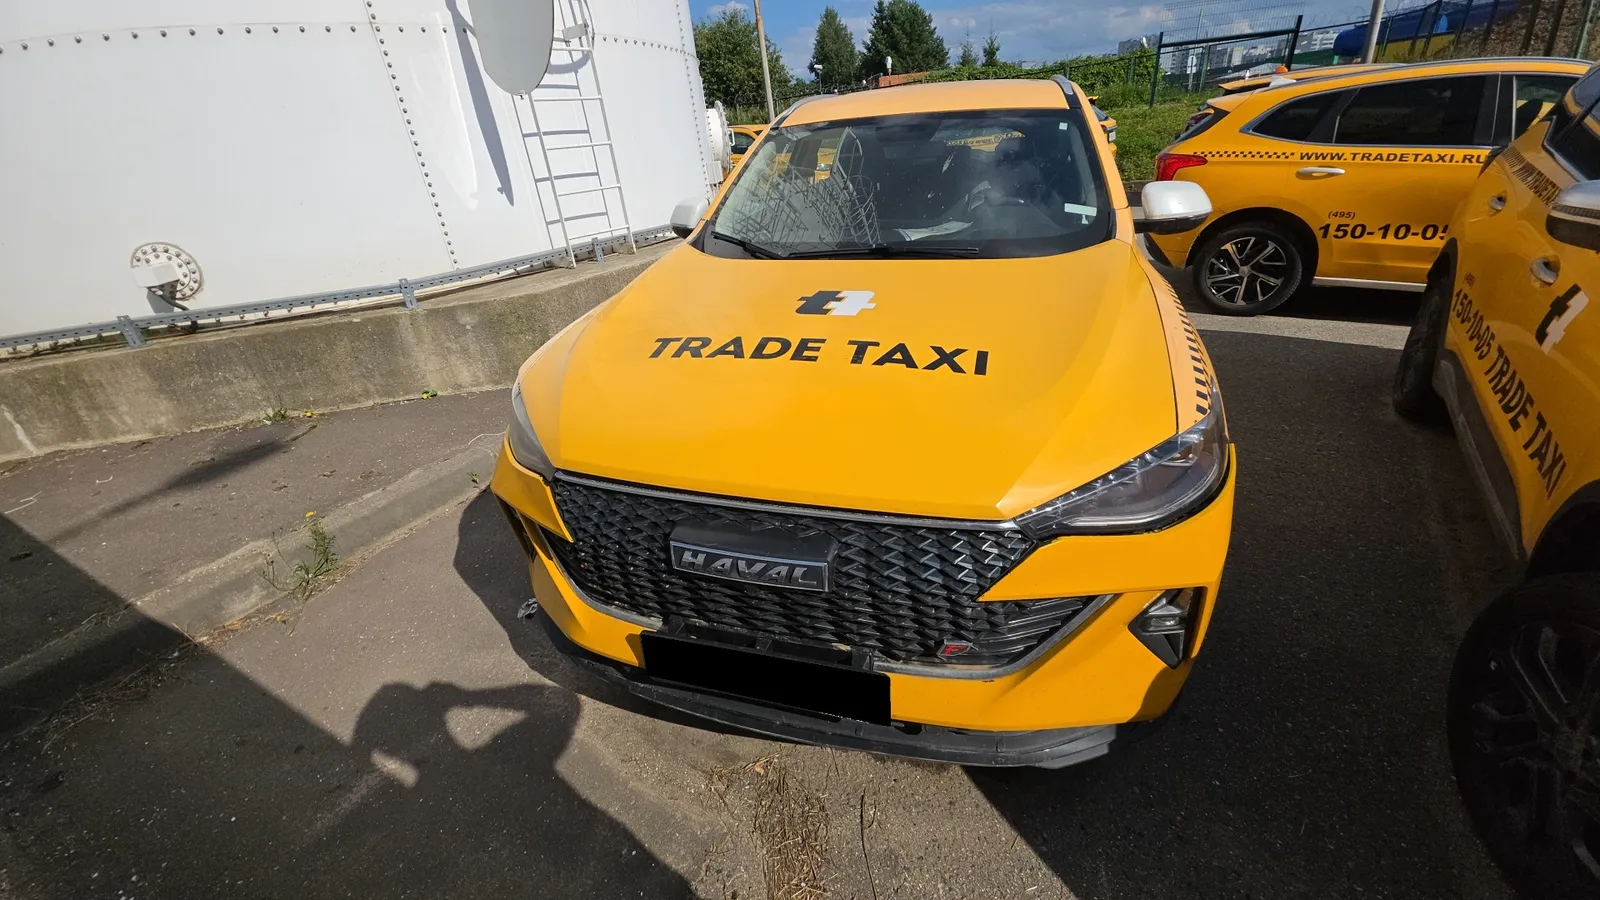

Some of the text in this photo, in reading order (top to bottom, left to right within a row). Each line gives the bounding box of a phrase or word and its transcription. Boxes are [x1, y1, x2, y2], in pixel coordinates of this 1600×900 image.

[1300, 152, 1488, 164] WWW.TRADETAXI.RU
[1328, 210, 1356, 220] (495)
[648, 336, 989, 376] TRADE TAXI
[1452, 288, 1567, 501] 150-10-05 TRADE TAXI
[681, 550, 817, 585] HAVAL
